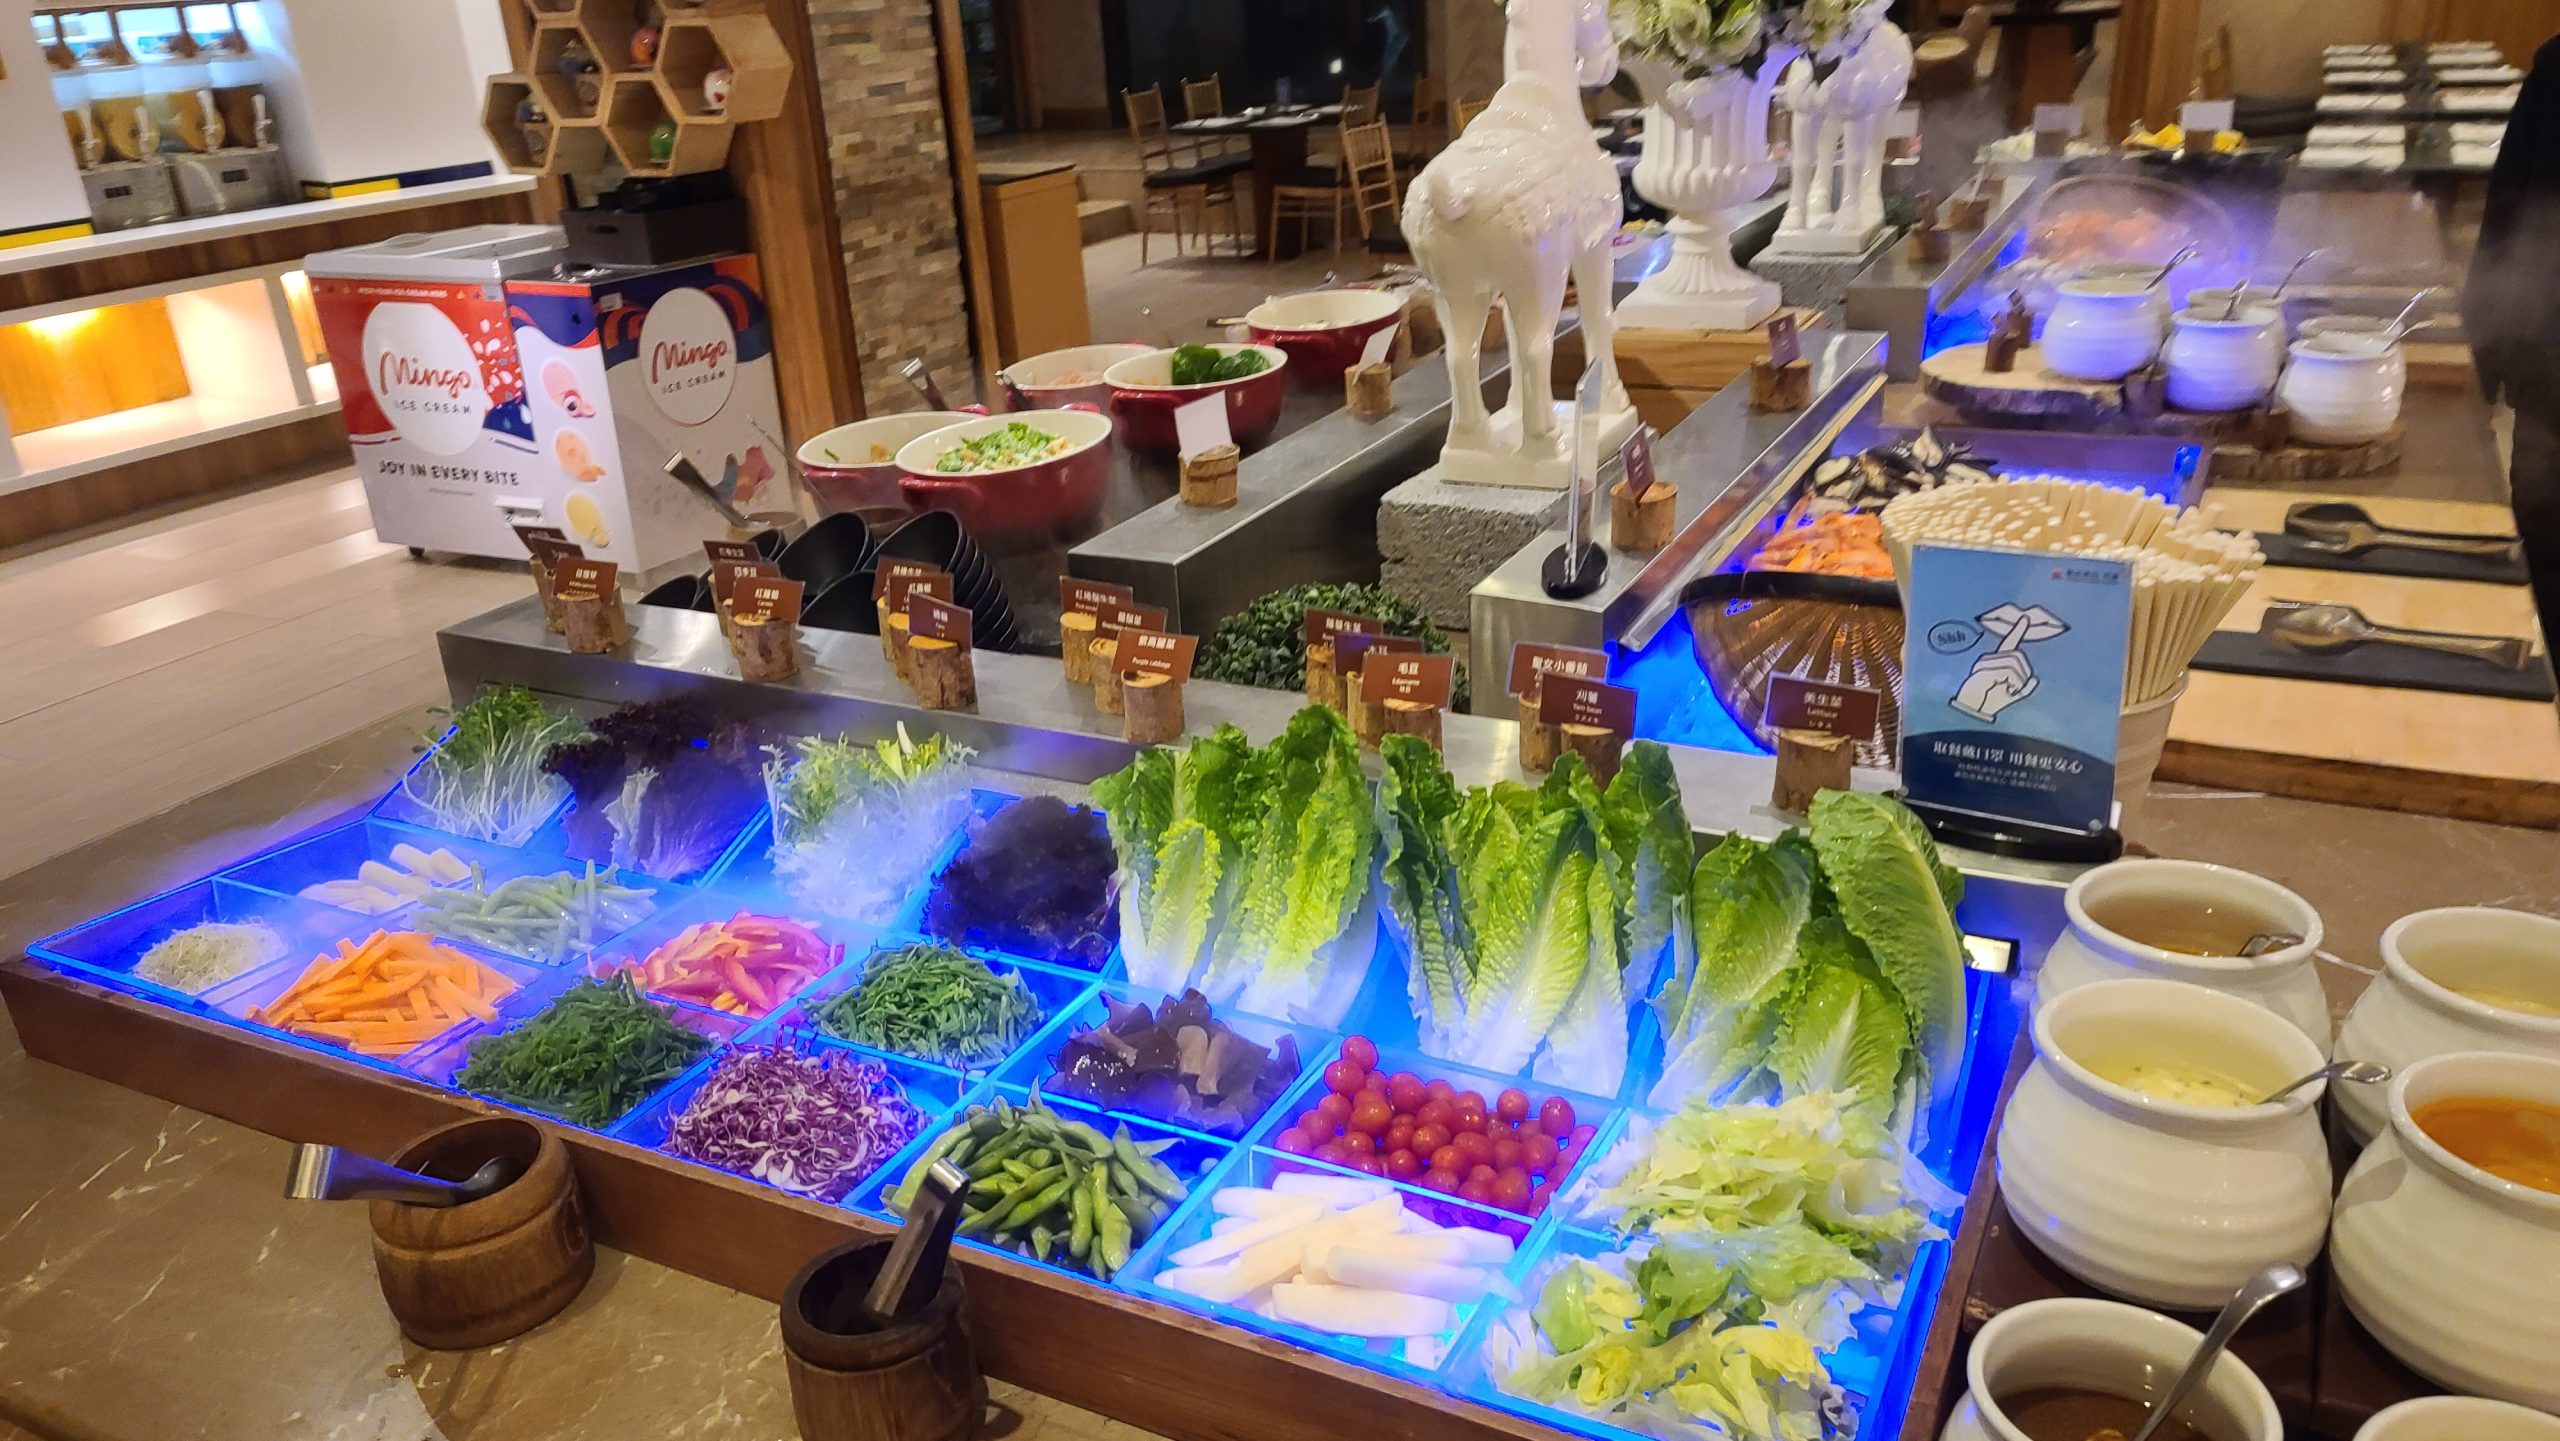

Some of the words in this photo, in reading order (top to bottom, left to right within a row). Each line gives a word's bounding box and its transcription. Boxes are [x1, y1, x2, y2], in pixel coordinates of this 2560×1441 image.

[652, 340, 728, 384] Mingo
[380, 351, 472, 399] Mingo
[662, 381, 682, 393] ICE
[687, 369, 725, 387] CREAM
[393, 399, 416, 411] ICE
[424, 400, 472, 415] CREAM
[378, 459, 405, 476] JOY
[410, 462, 427, 478] IN
[430, 465, 479, 482] EVERY
[484, 469, 519, 486] BITE
[1397, 661, 1419, 676] 毛豆
